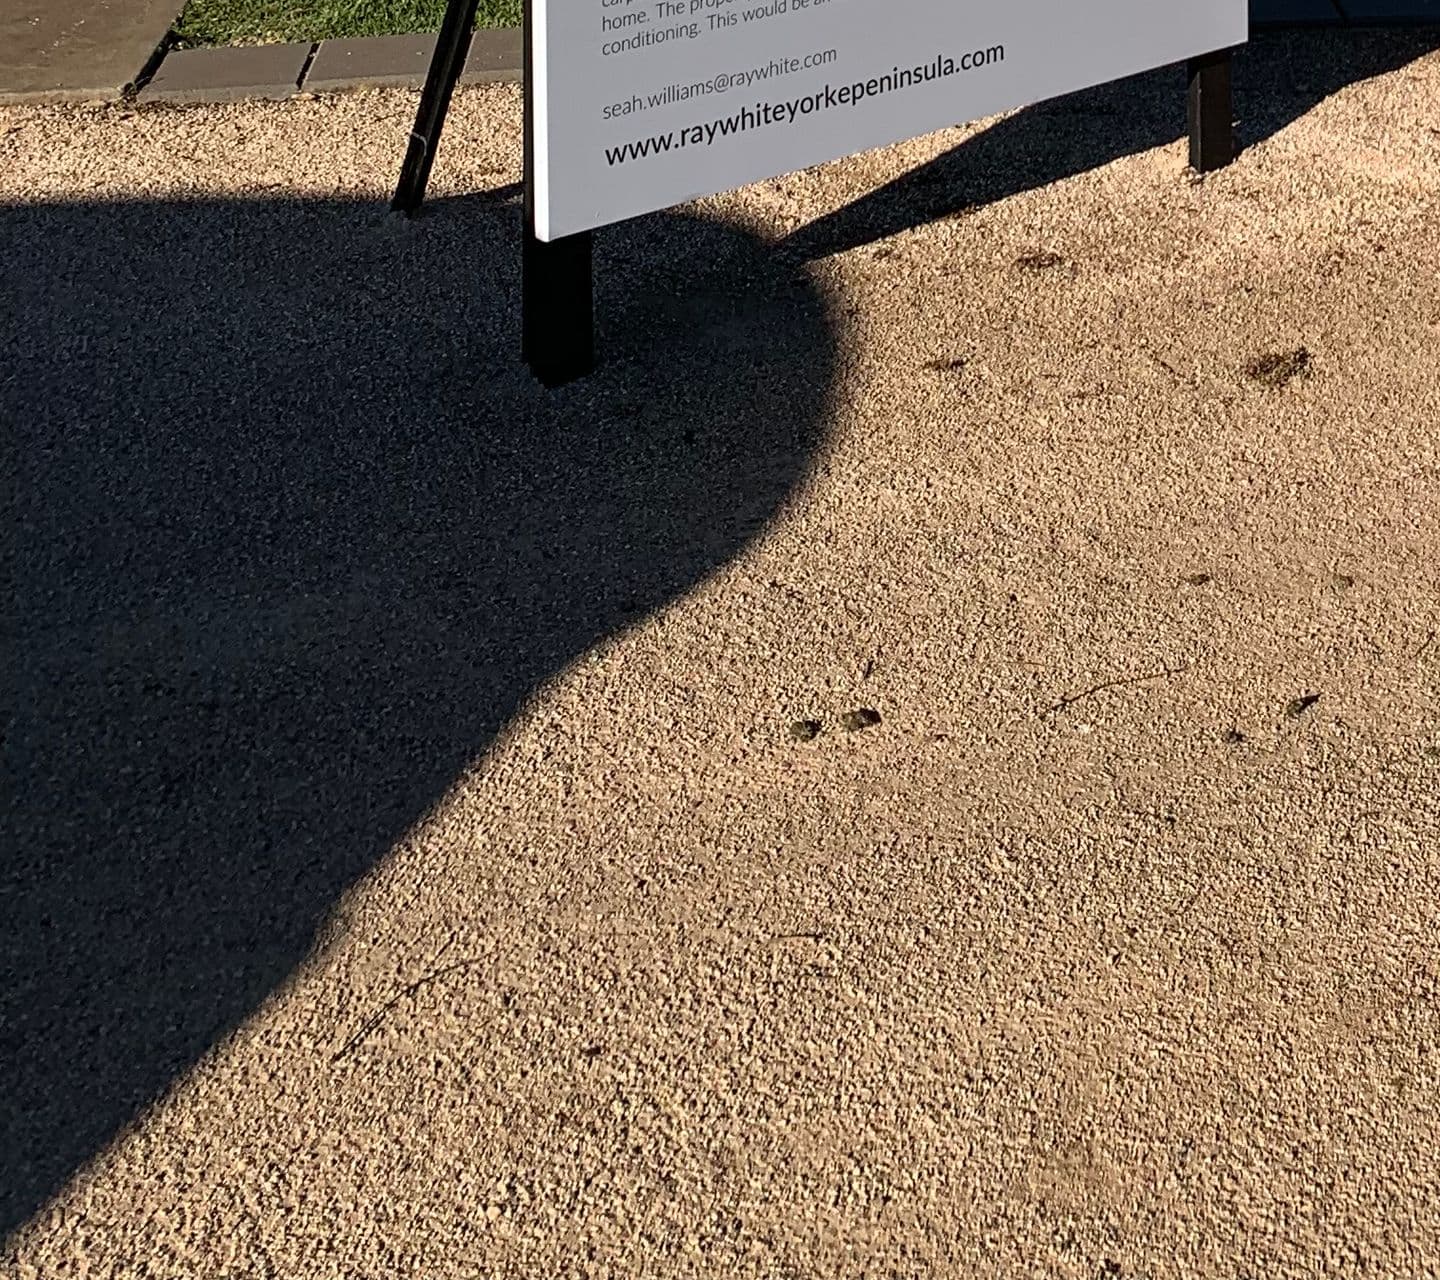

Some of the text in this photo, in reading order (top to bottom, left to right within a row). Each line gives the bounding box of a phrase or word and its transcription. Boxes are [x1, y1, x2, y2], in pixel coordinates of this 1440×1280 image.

[602, 10, 650, 32] home.
[655, 1, 685, 18] The
[602, 23, 701, 55] conditioning.
[705, 10, 738, 30] This
[602, 49, 836, 119] seah.williams@raywhite.com
[605, 44, 1004, 166] www.raywhiteyorkepeninsula.com
